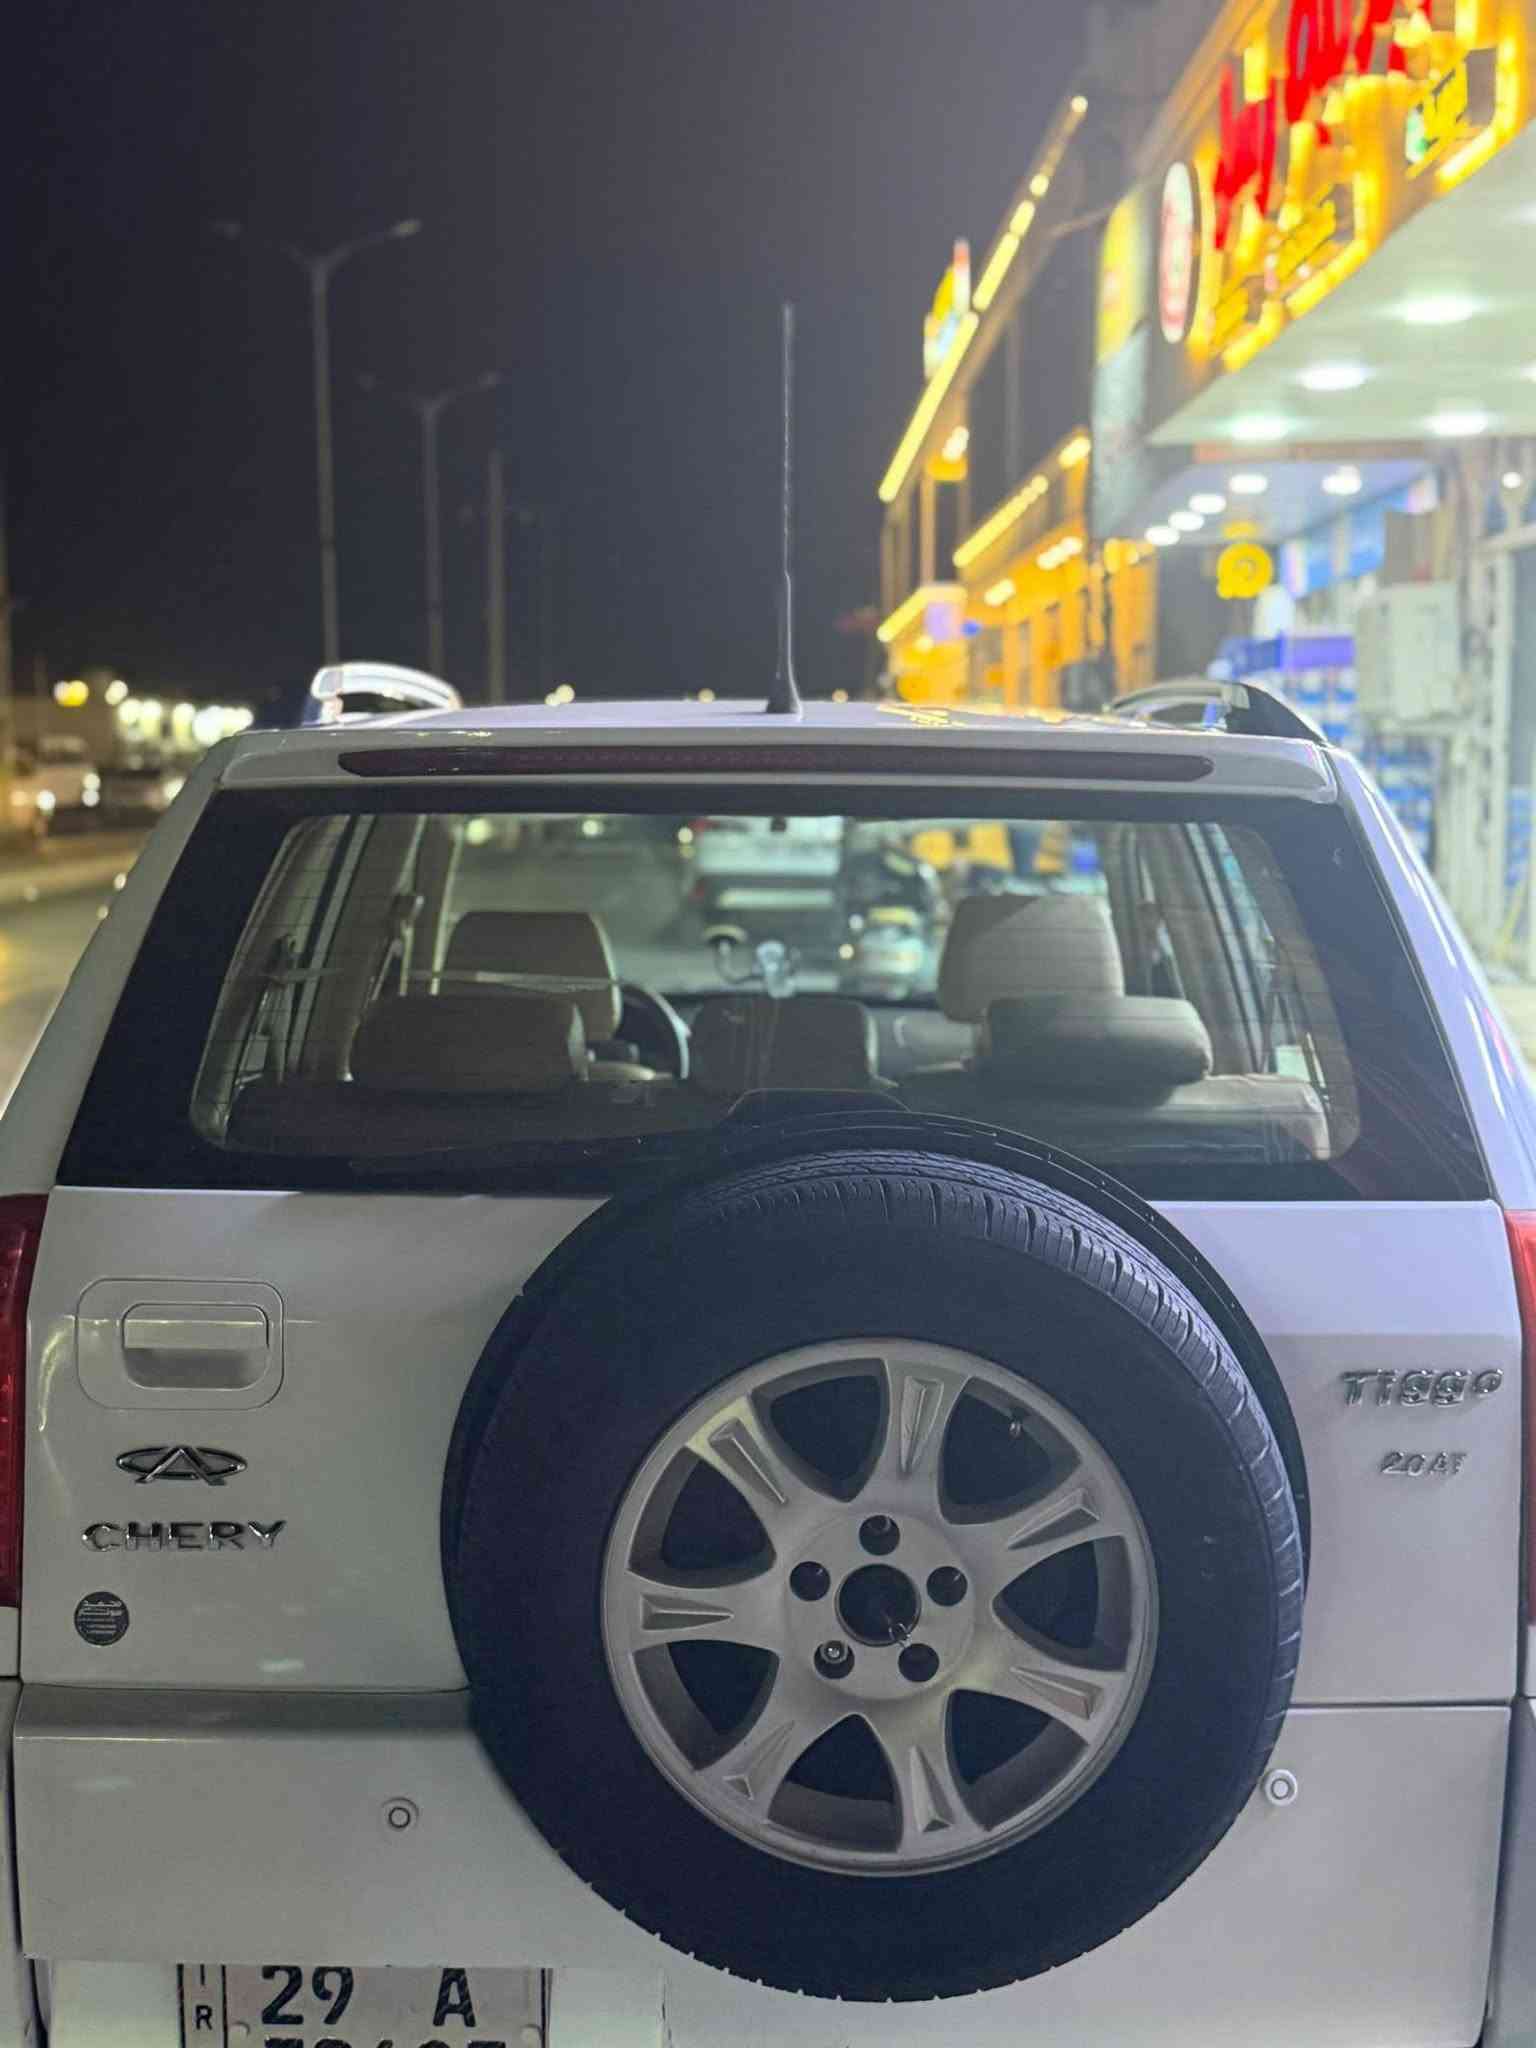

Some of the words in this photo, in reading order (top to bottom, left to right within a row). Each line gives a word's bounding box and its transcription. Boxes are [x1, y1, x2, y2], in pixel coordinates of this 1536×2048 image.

[80, 1520, 287, 1552] CHERY
[261, 1965, 354, 2025] 29
[432, 1967, 477, 2028] A
